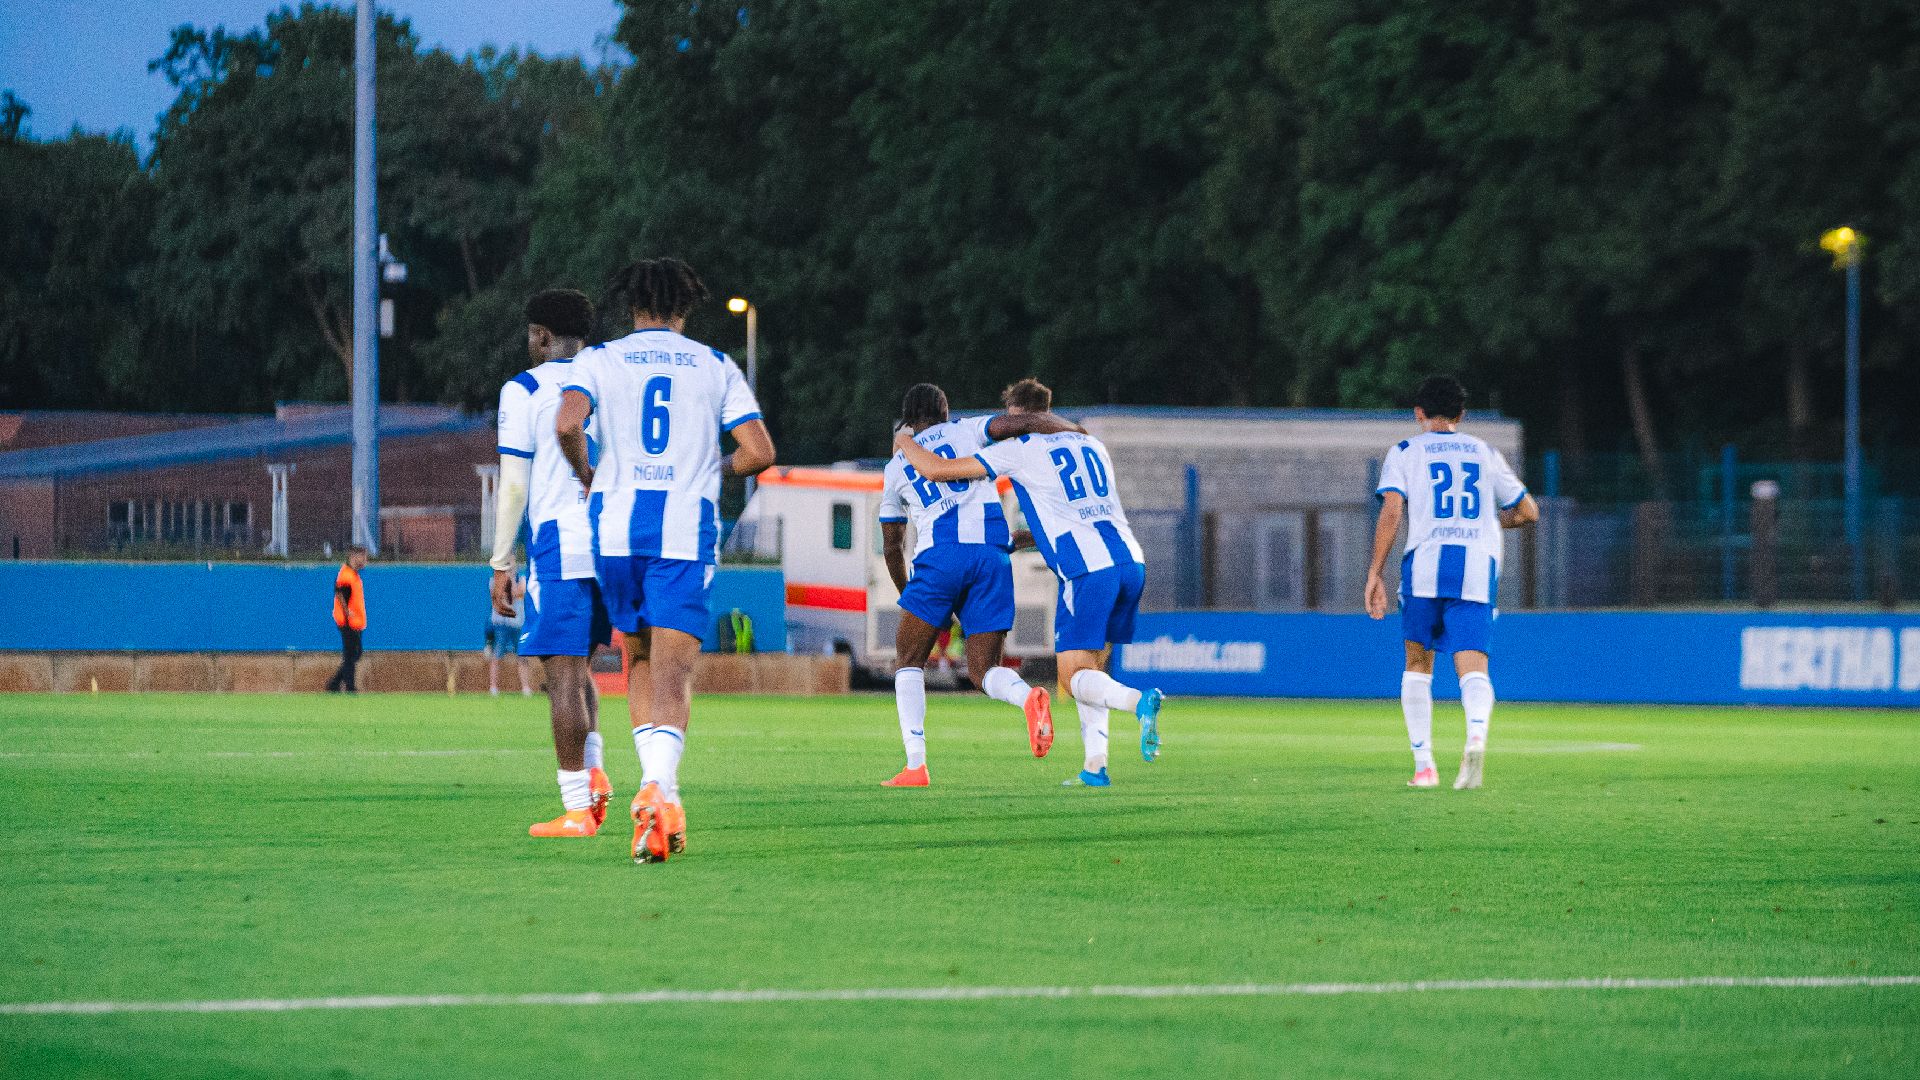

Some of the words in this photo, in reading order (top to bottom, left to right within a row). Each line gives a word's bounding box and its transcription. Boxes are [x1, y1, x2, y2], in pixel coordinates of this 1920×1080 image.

[624, 350, 671, 365] HERTHA
[675, 352, 698, 368] BSC
[640, 375, 673, 455] 6
[633, 465, 674, 481] NGWA
[1048, 446, 1109, 502] 20
[1429, 462, 1480, 519] 23
[1740, 627, 1894, 690] HERTHA
